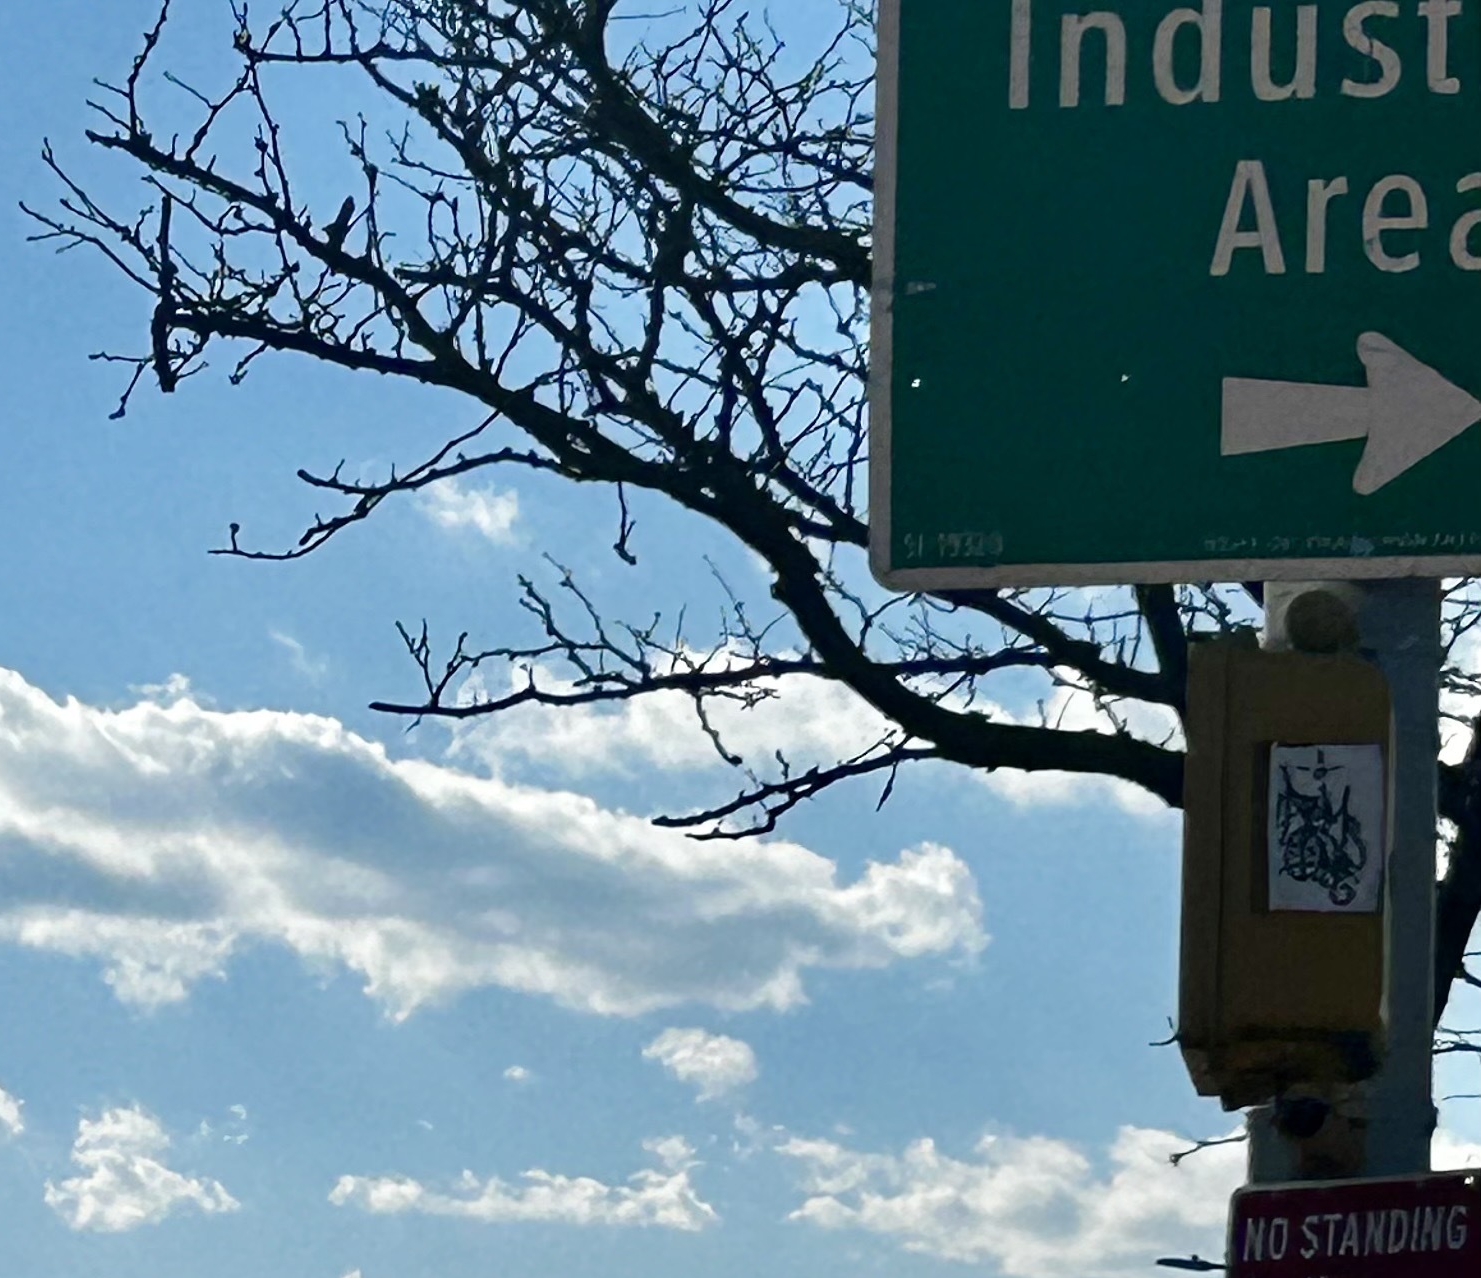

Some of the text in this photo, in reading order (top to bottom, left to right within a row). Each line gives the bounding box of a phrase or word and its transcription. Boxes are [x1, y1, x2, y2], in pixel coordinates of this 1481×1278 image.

[1008, 0, 1462, 109] Indust
[1242, 1204, 1469, 1262] NO STANDING
